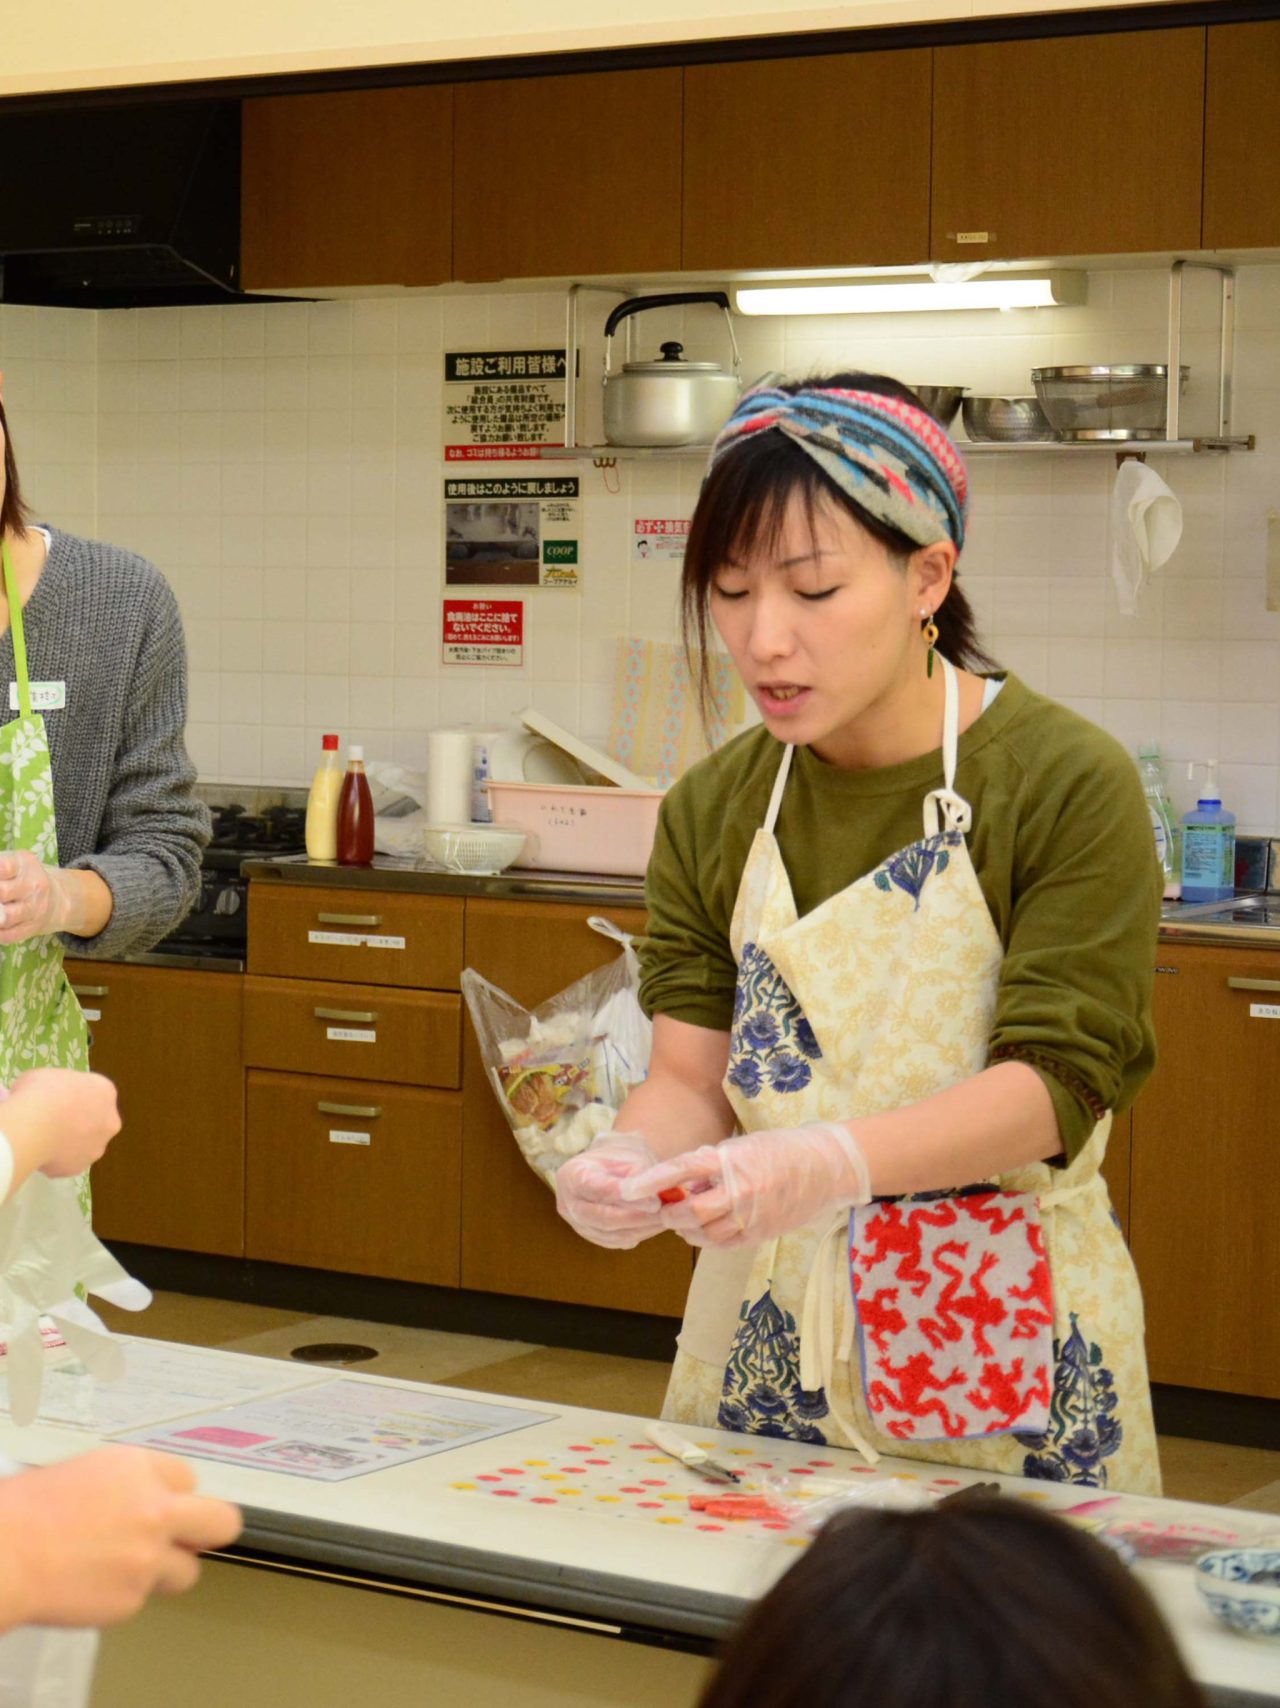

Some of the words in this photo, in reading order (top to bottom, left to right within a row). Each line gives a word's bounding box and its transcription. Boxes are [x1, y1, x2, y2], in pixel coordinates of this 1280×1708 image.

[455, 355, 567, 376] 施設ご利用皆様へ
[447, 481, 575, 496] 使用後はこのように戻しましょう
[546, 545, 574, 556] COOP
